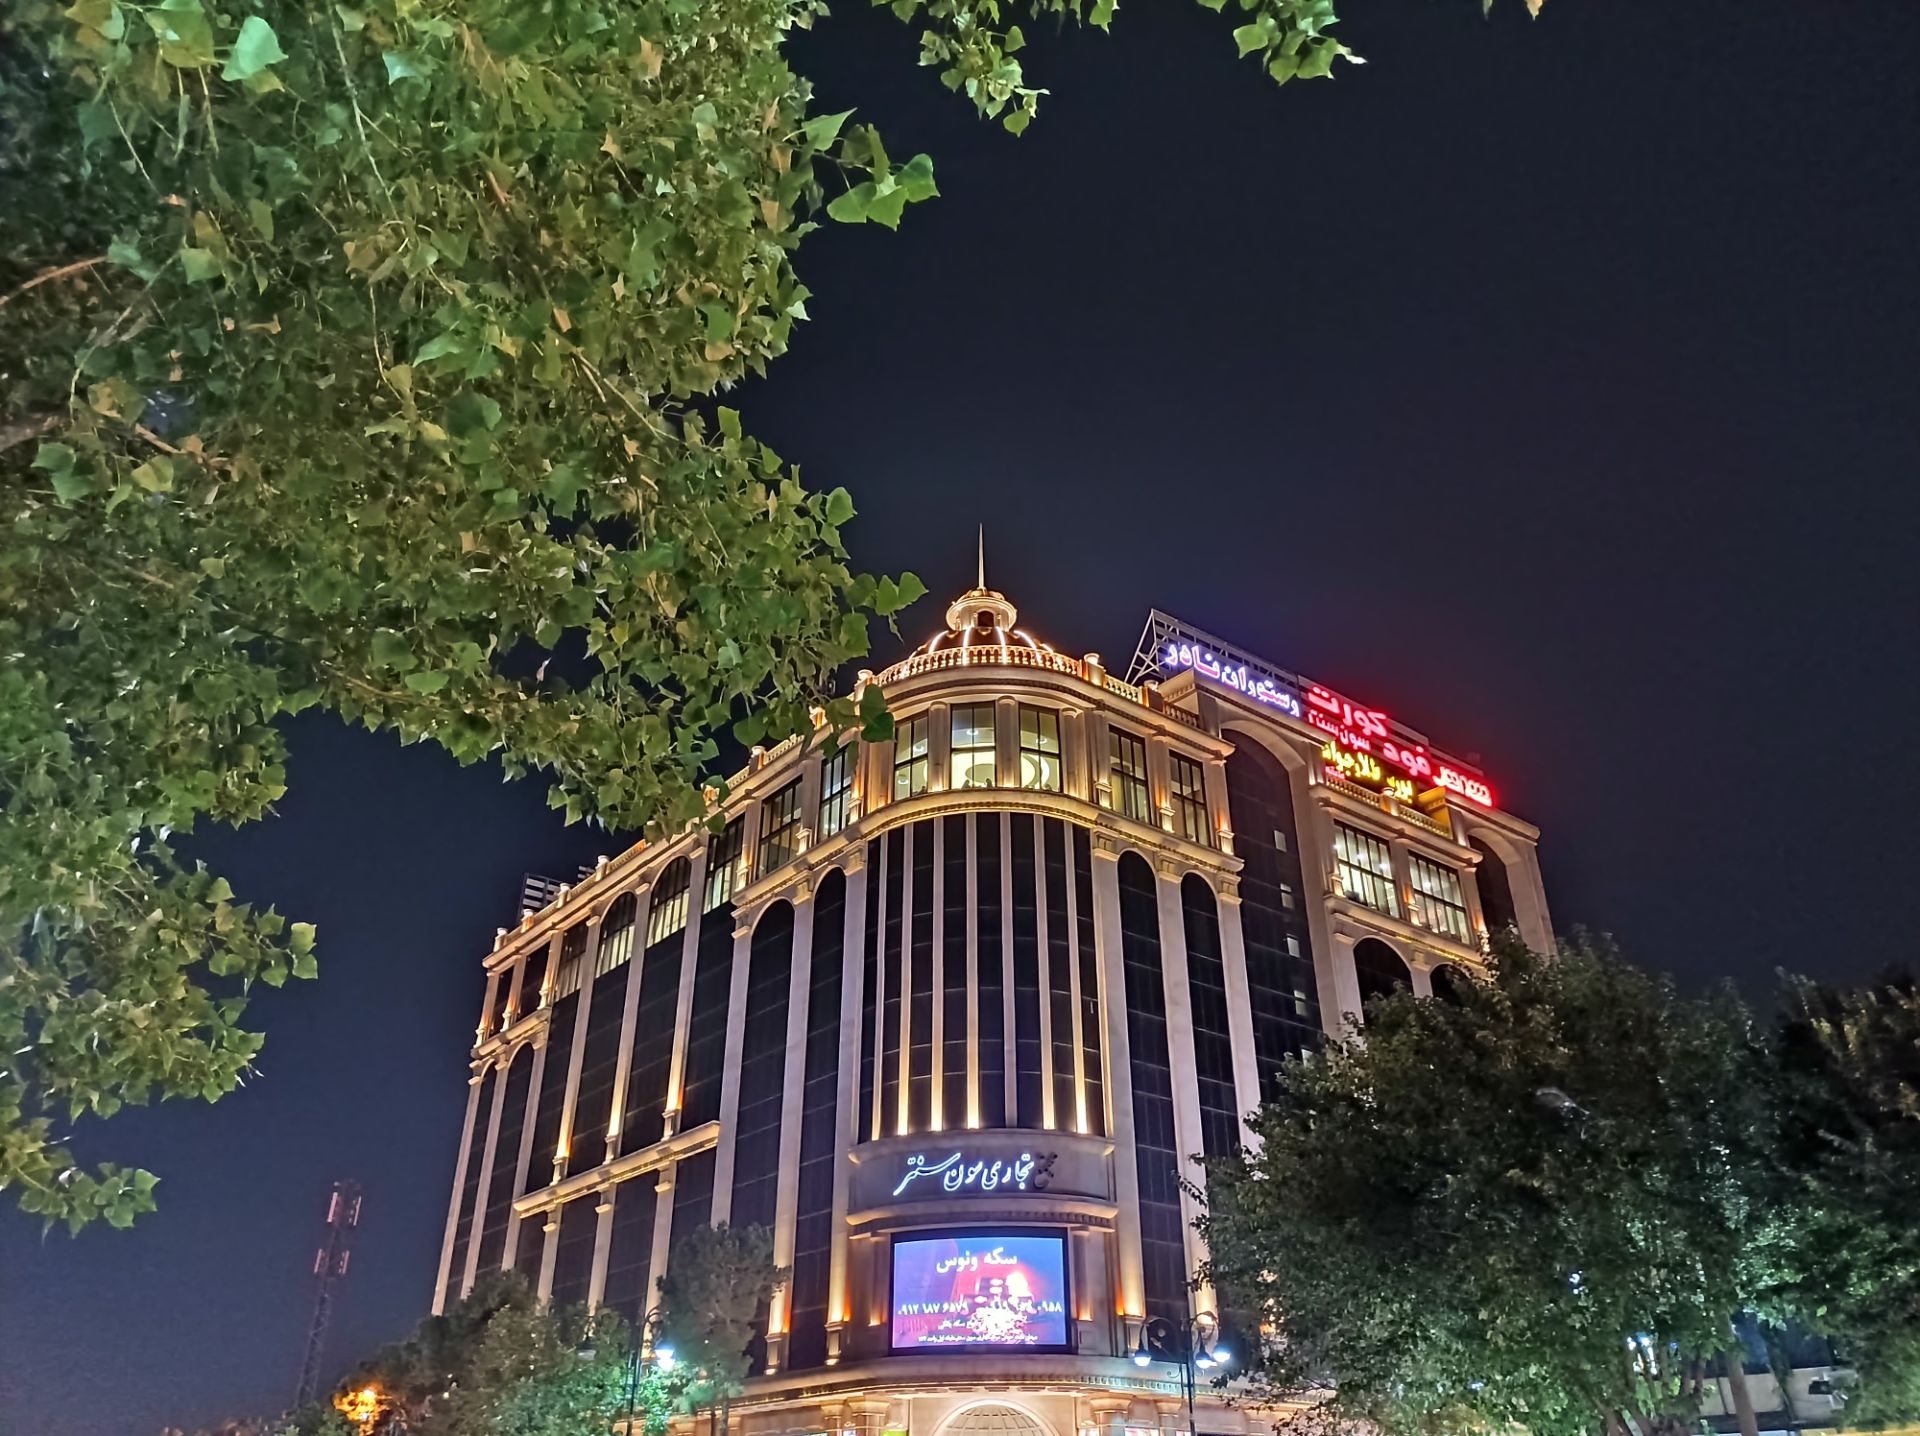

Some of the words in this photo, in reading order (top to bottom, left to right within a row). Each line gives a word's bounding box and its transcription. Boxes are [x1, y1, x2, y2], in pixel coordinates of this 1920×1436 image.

[1308, 685, 1388, 737] کورت
[1383, 742, 1432, 776] فود
[892, 1152, 963, 1196] سنتر
[943, 1161, 983, 1191] سون
[981, 1153, 1035, 1190] تجاری
[936, 1250, 978, 1273] ونوس
[983, 1246, 1018, 1265] سکه
